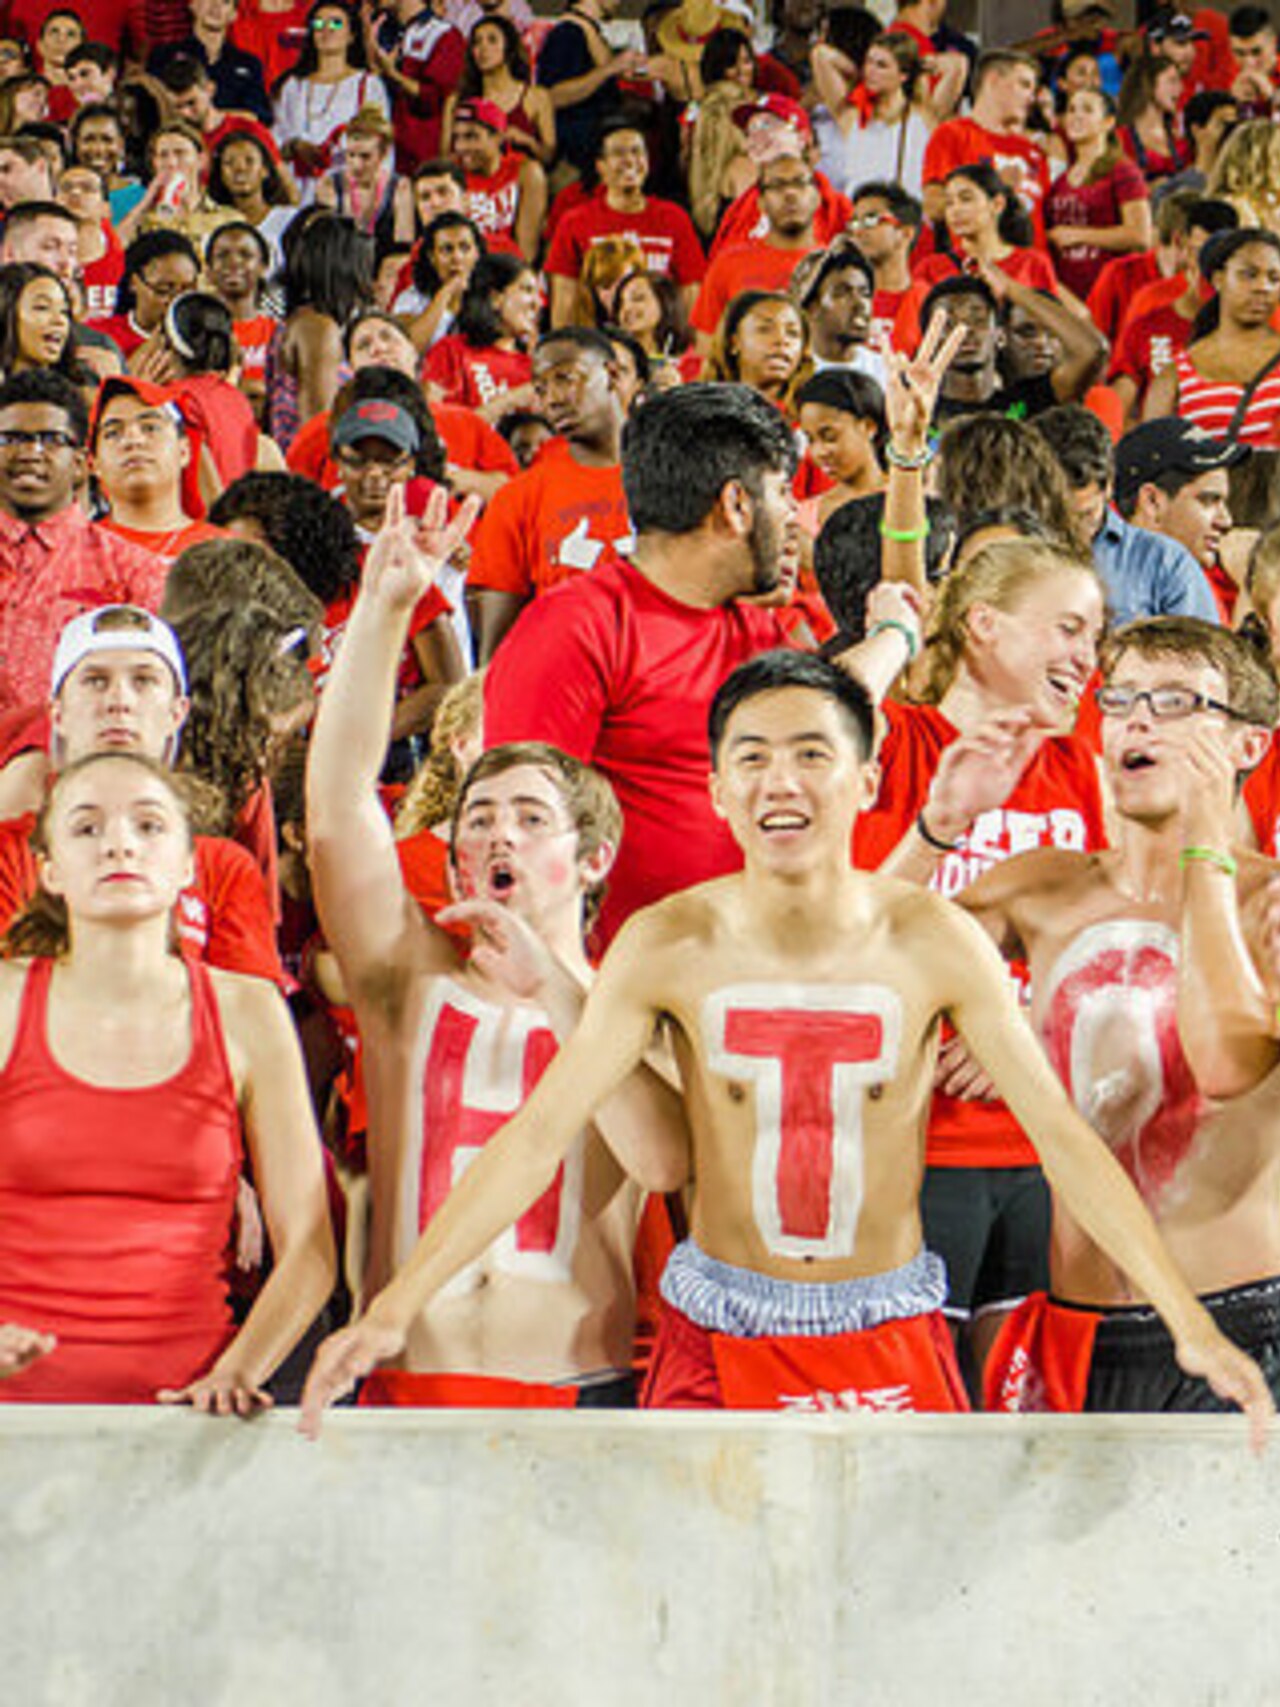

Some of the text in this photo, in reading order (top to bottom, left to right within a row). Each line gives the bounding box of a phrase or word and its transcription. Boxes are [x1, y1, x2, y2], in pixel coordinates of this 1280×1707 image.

[402, 976, 584, 1283] H
[702, 982, 902, 1259] T
[1041, 917, 1205, 1215] O
